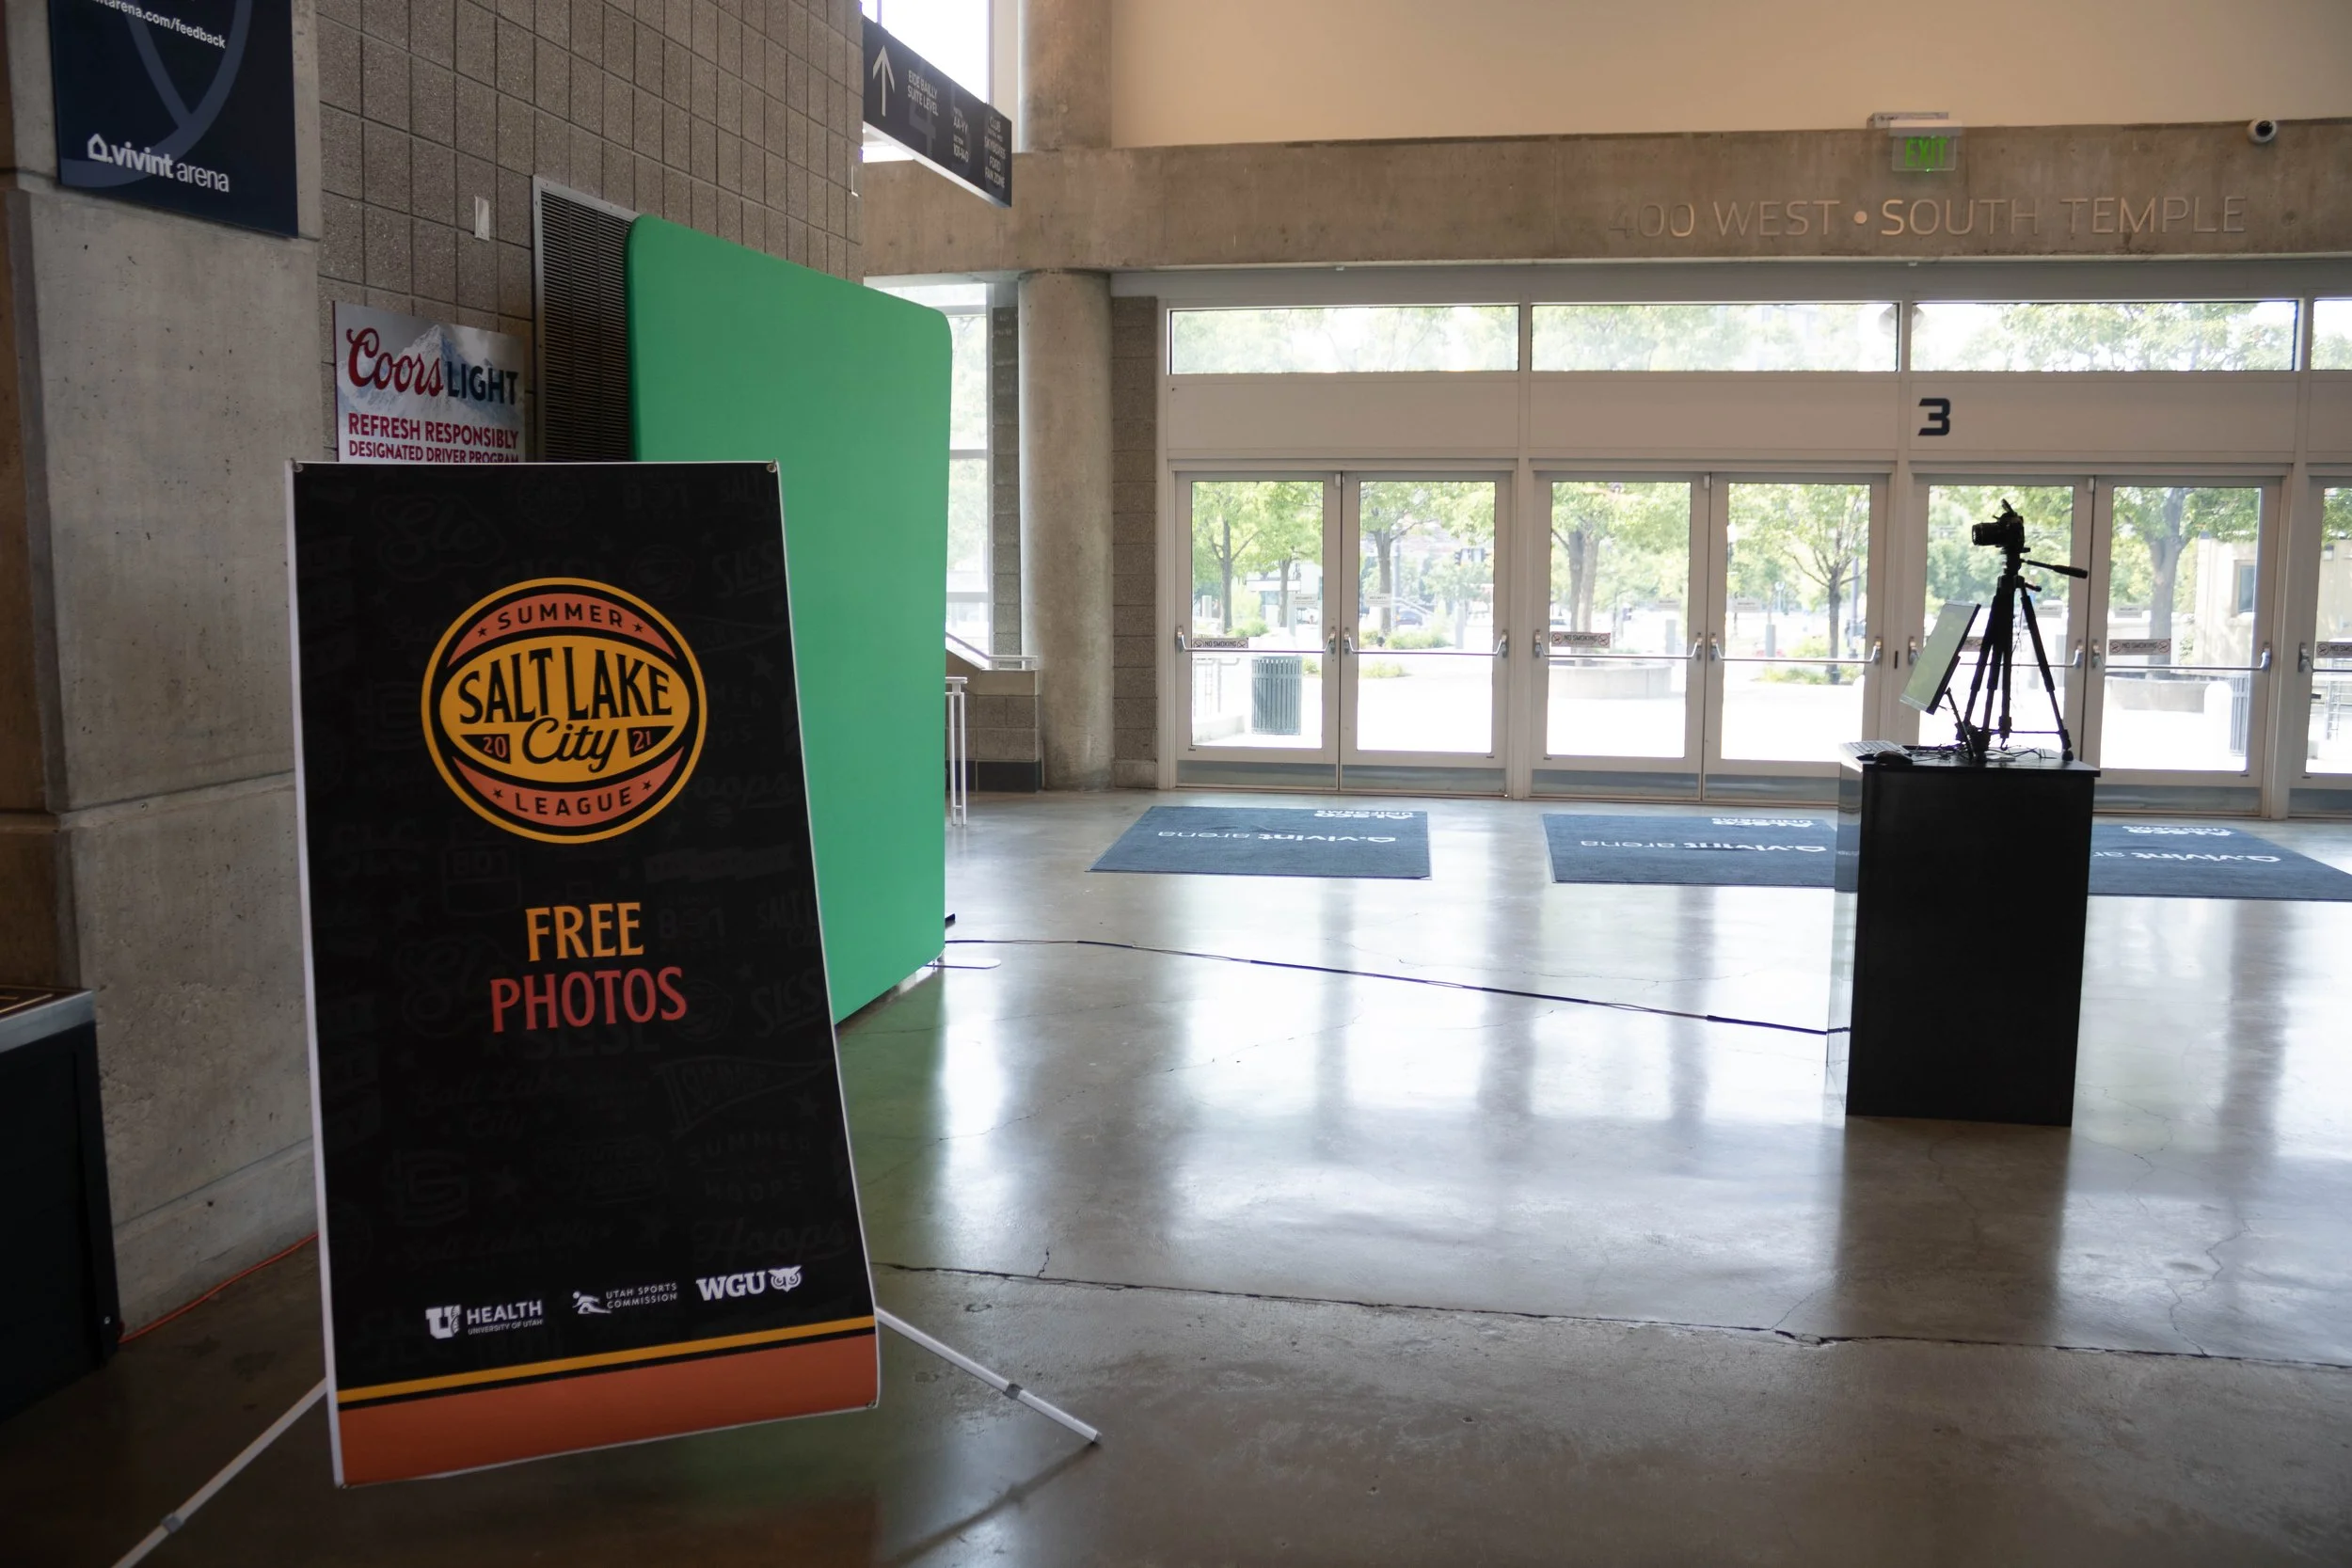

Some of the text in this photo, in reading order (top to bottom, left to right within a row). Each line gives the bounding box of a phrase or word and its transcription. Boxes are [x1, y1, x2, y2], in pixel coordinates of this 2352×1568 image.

[907, 85, 939, 117] SUITE LEVEL
[110, 142, 230, 192] vivint arena
[1905, 136, 1948, 167] EXIT
[1609, 196, 2247, 238] 400 WEST SOUTH TEMPLE
[346, 327, 518, 404] Coors LIGHT
[348, 412, 519, 450] REFRESH RESPONSIBLY
[1918, 398, 1951, 436] 3
[349, 440, 518, 463] DESIGNATED DRIVER PROGRAM
[497, 602, 623, 631] SUMMER
[457, 646, 673, 724] SALT LAKE
[483, 717, 652, 773] 20 City 21
[515, 786, 632, 816] LEAGUE
[1258, 833, 1359, 842] vivint
[525, 902, 644, 961] FREE
[490, 966, 688, 1033] PHOTOS
[606, 1282, 677, 1299] UTAH SPORTS
[607, 1293, 677, 1309] COMMISSION
[696, 1271, 766, 1301] WGU
[467, 1300, 543, 1324] HEALTH
[468, 1323, 510, 1335] UNIVERSITY
[523, 1319, 543, 1327] UTAH
